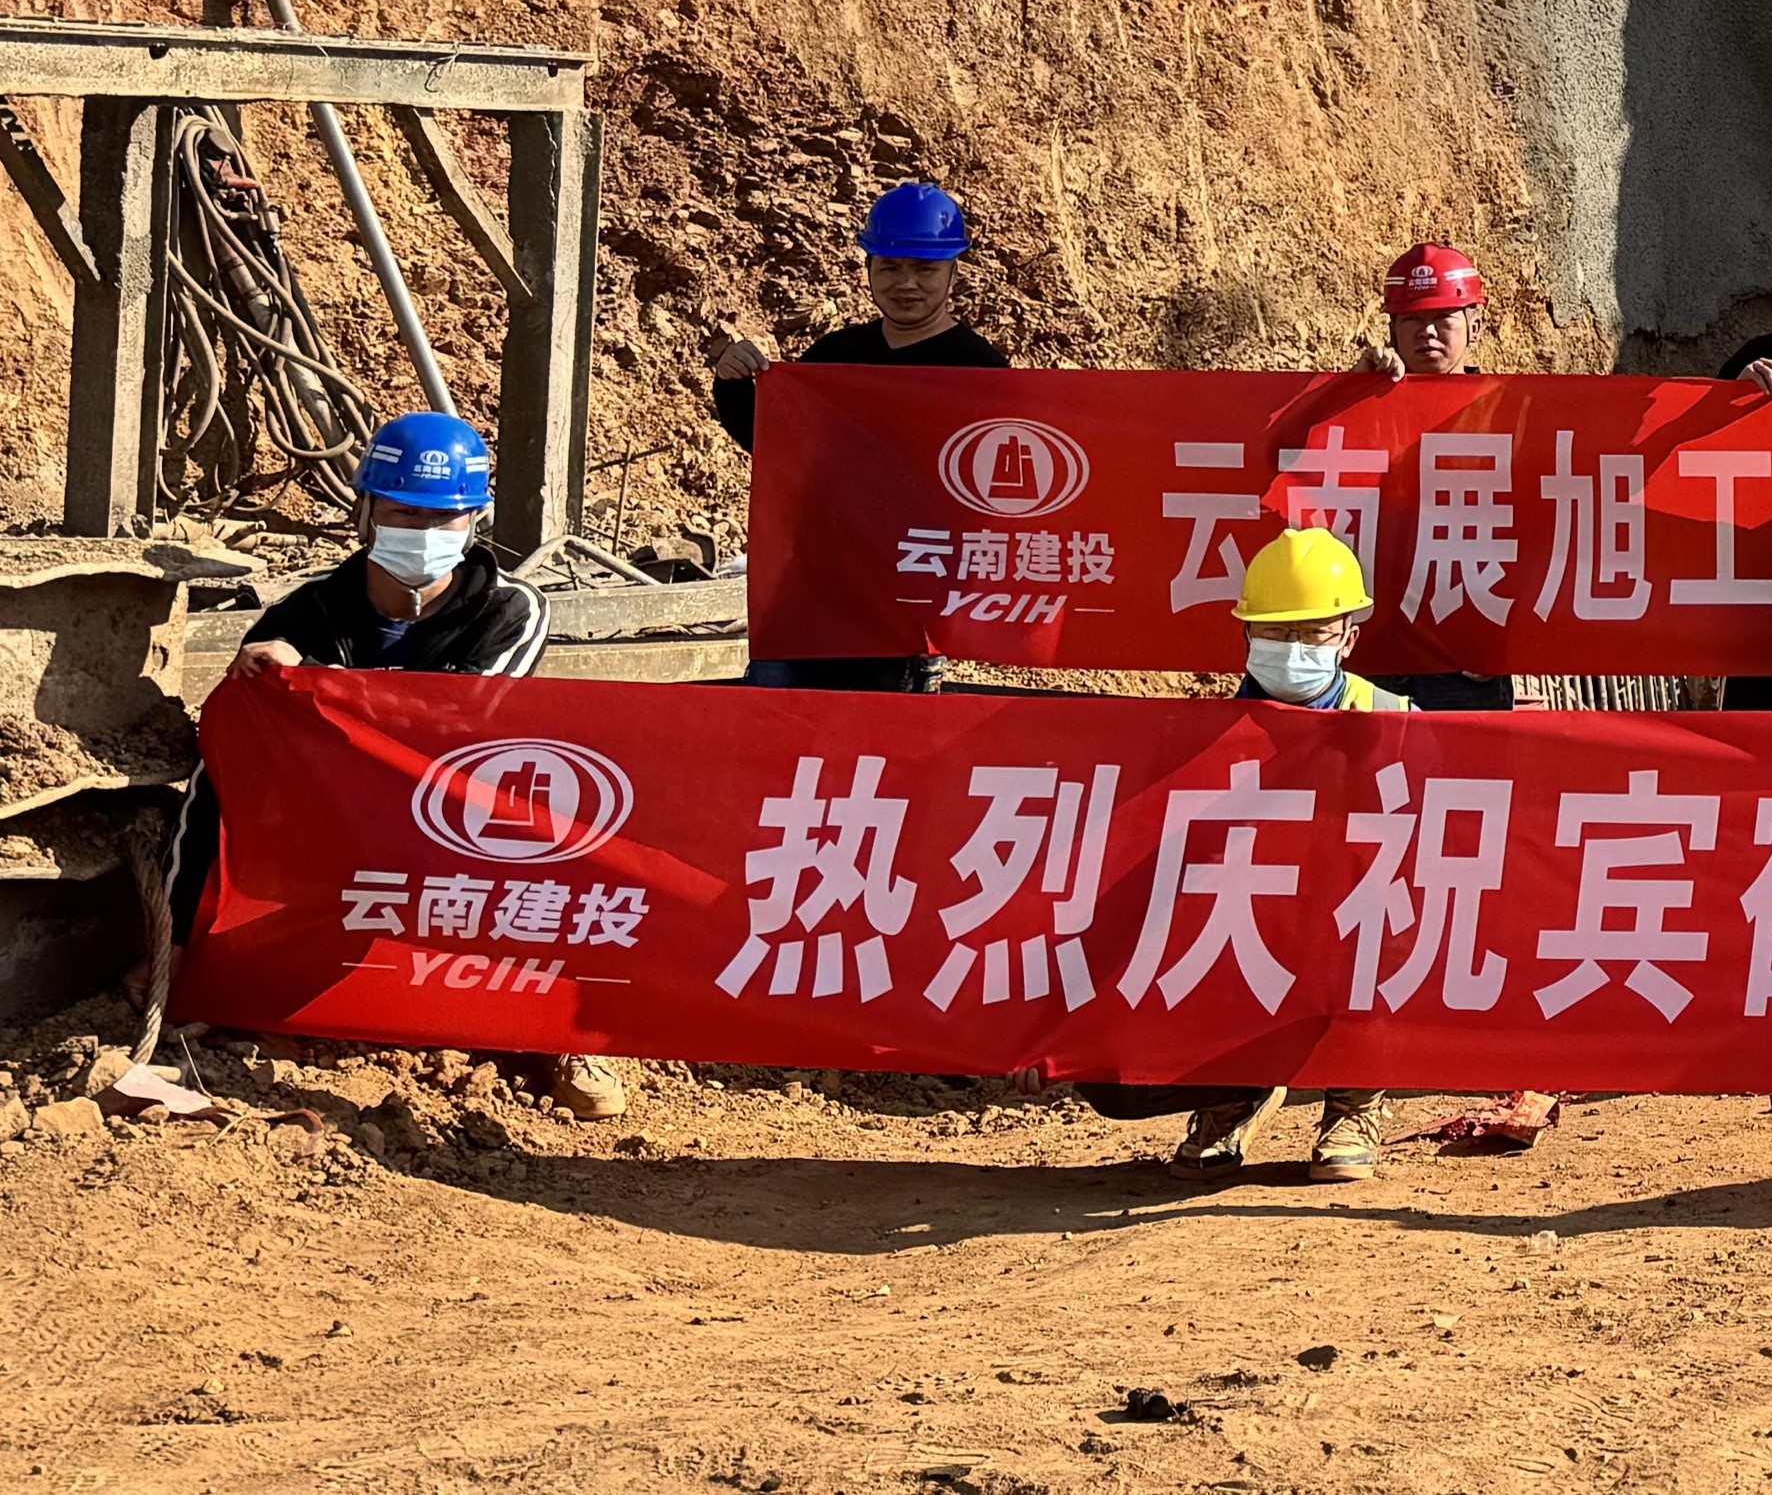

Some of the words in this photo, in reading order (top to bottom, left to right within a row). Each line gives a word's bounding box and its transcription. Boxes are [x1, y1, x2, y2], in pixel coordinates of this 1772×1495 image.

[895, 526, 1117, 587] 云南建投
[938, 590, 1068, 624] YCIH
[339, 869, 652, 949] 云南建投
[400, 951, 567, 996] YCIH
